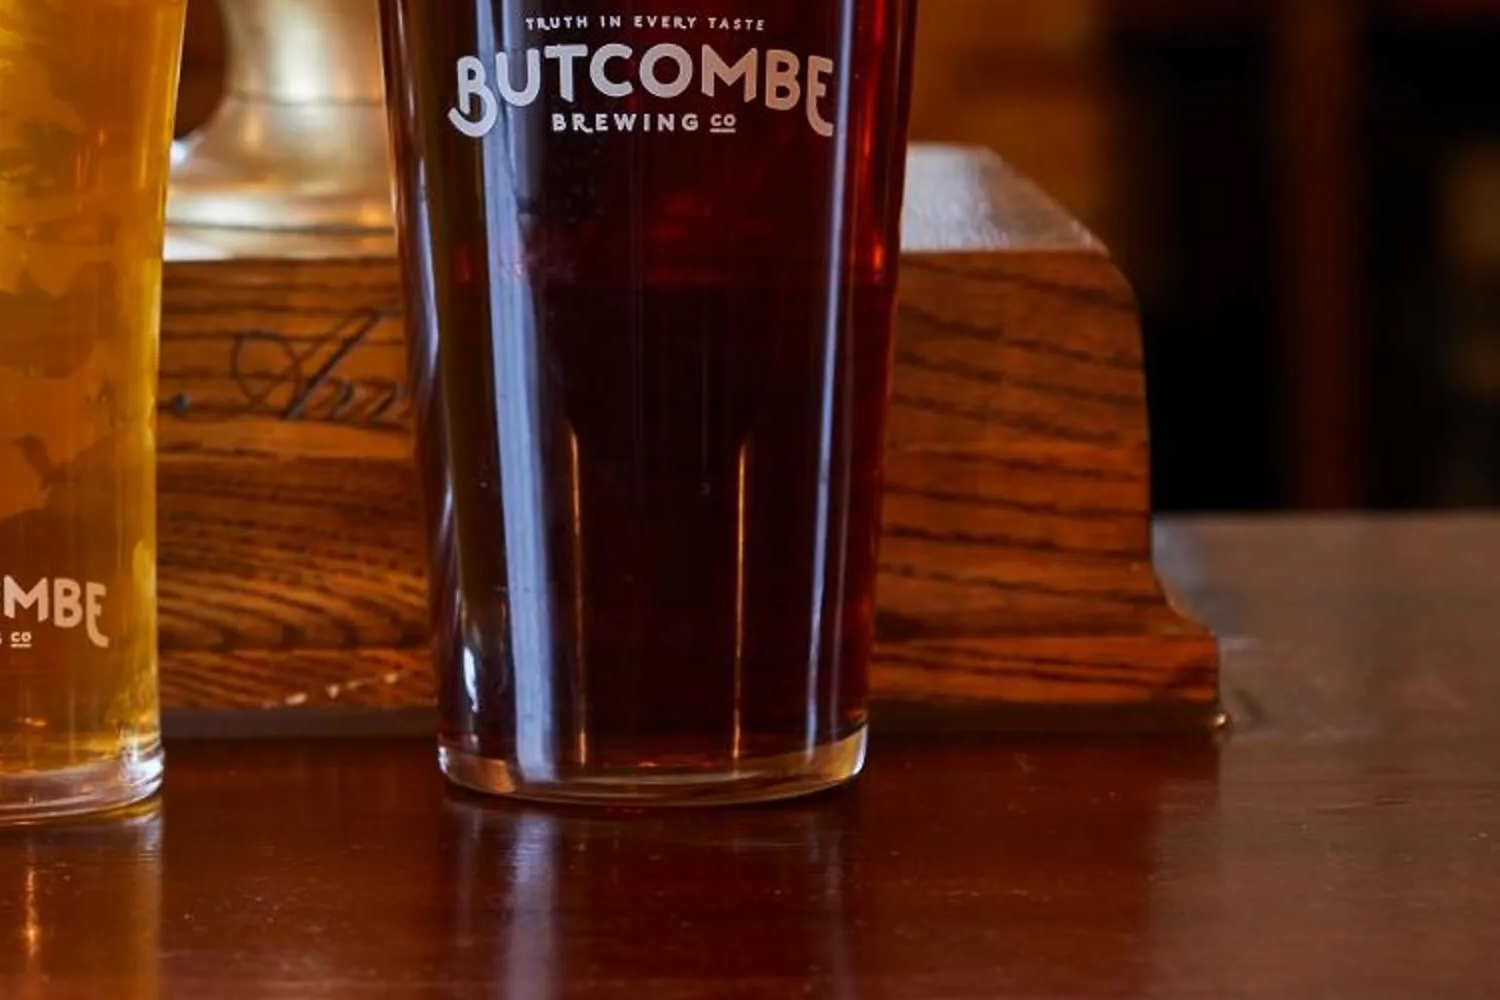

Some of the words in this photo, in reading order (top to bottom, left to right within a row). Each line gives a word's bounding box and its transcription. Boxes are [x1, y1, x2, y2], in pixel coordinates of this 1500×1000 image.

[525, 15, 588, 31] TRUTH
[600, 15, 622, 28] IN
[633, 15, 698, 31] EVERY
[708, 16, 766, 31] TASTE
[447, 43, 835, 137] BUTCOMBE
[552, 113, 699, 134] BREWING
[710, 113, 737, 133] CO
[10, 631, 33, 648] CO
